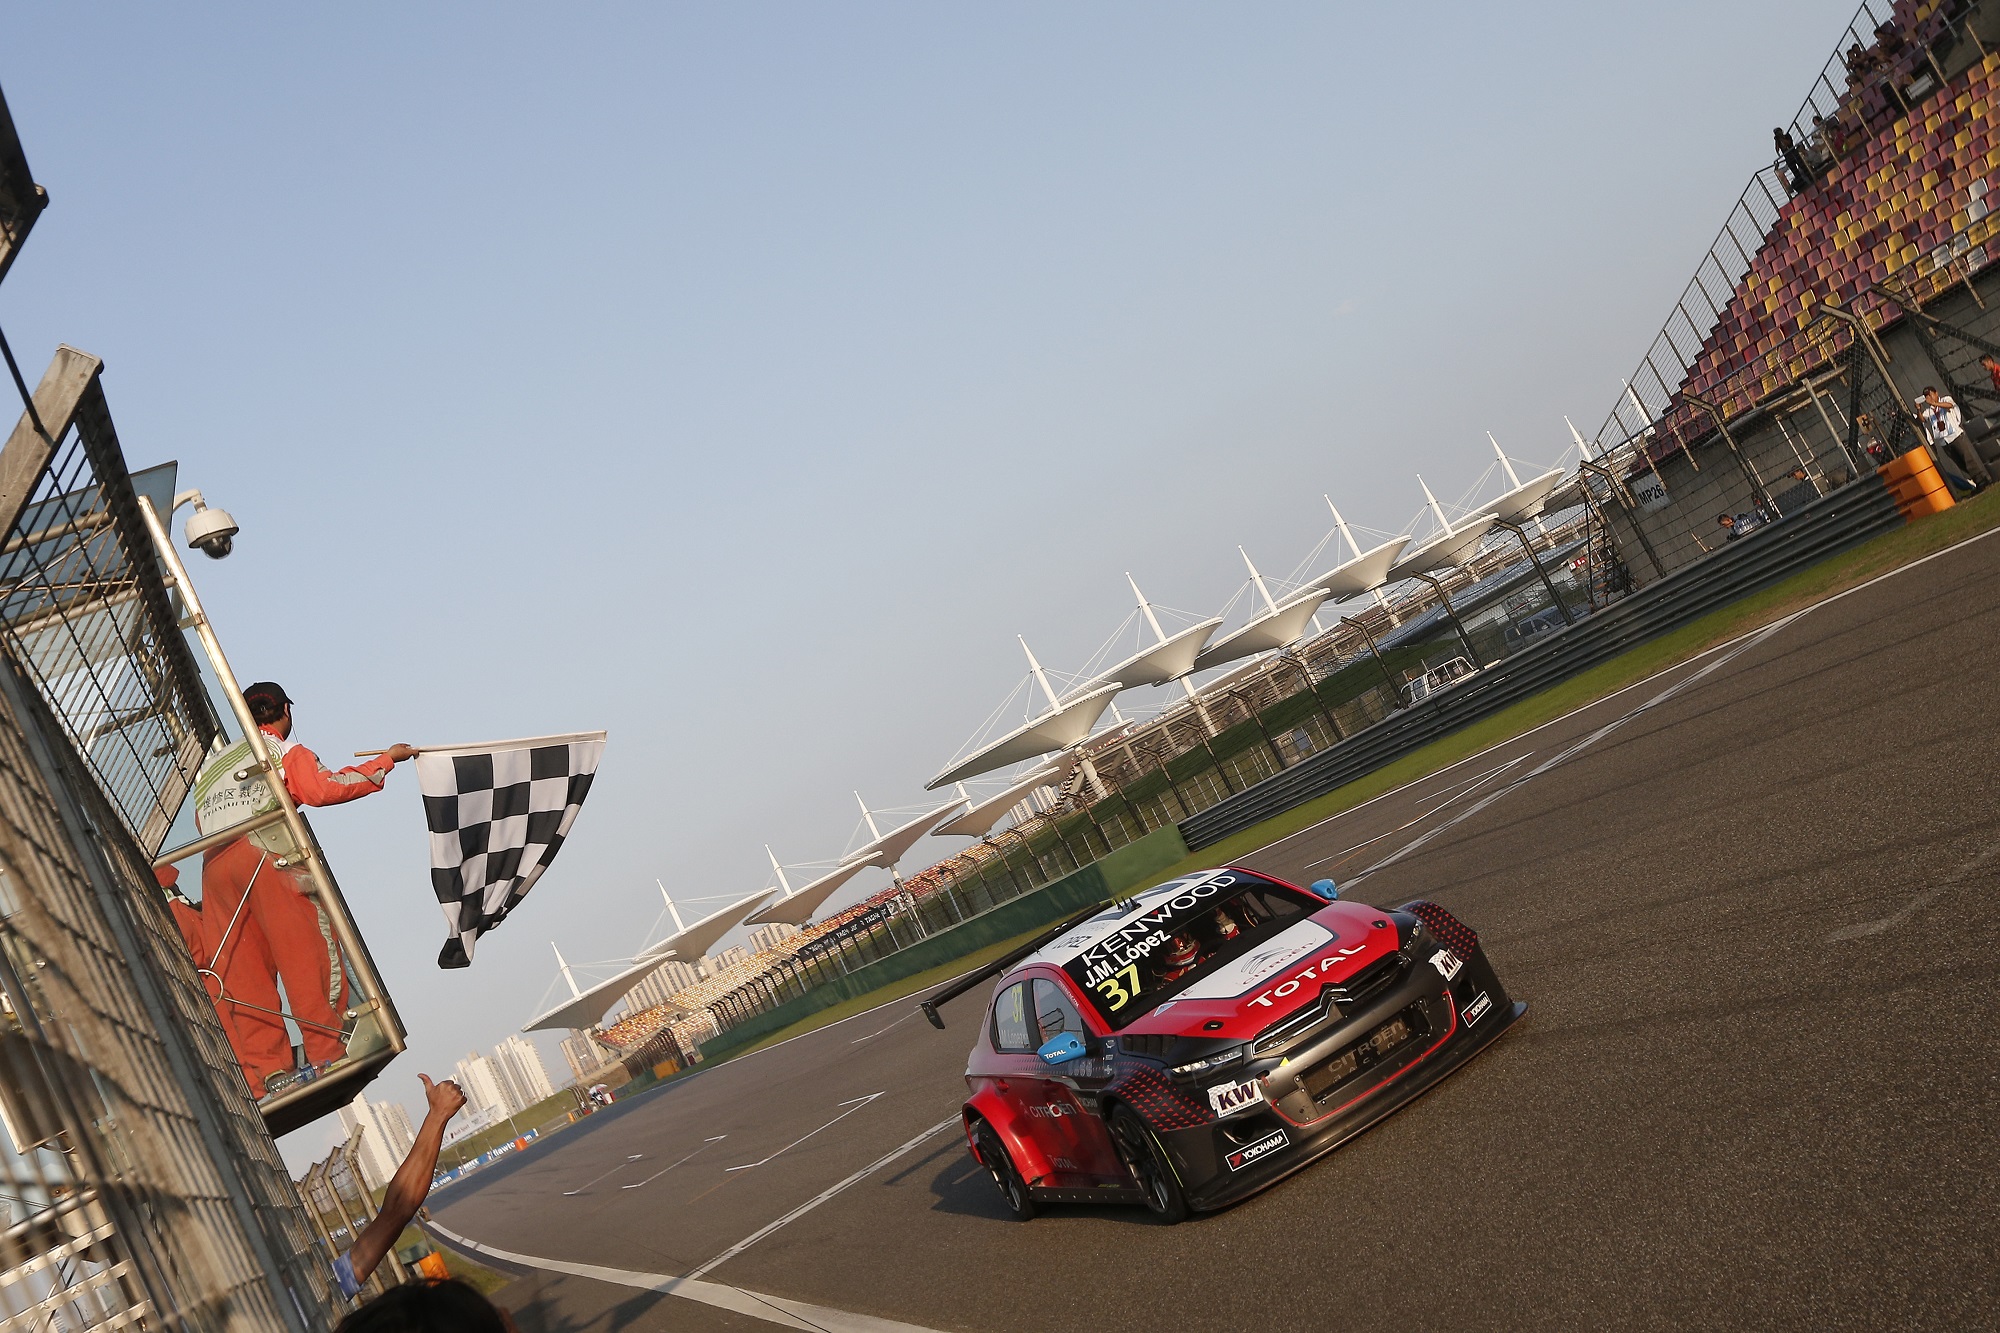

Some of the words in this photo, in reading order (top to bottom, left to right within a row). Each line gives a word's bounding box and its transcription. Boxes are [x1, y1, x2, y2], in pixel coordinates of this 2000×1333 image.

[1638, 484, 1665, 506] MP26
[1081, 875, 1237, 967] KENWOOD
[1085, 962, 1119, 989] J.M.
[1112, 929, 1172, 967] López
[1247, 944, 1367, 1008] TOTAL
[1096, 963, 1142, 1013] 37
[1044, 1048, 1067, 1060] TOTAL
[1218, 1081, 1255, 1111] KW
[1242, 1134, 1284, 1160] YOKOHAMA
